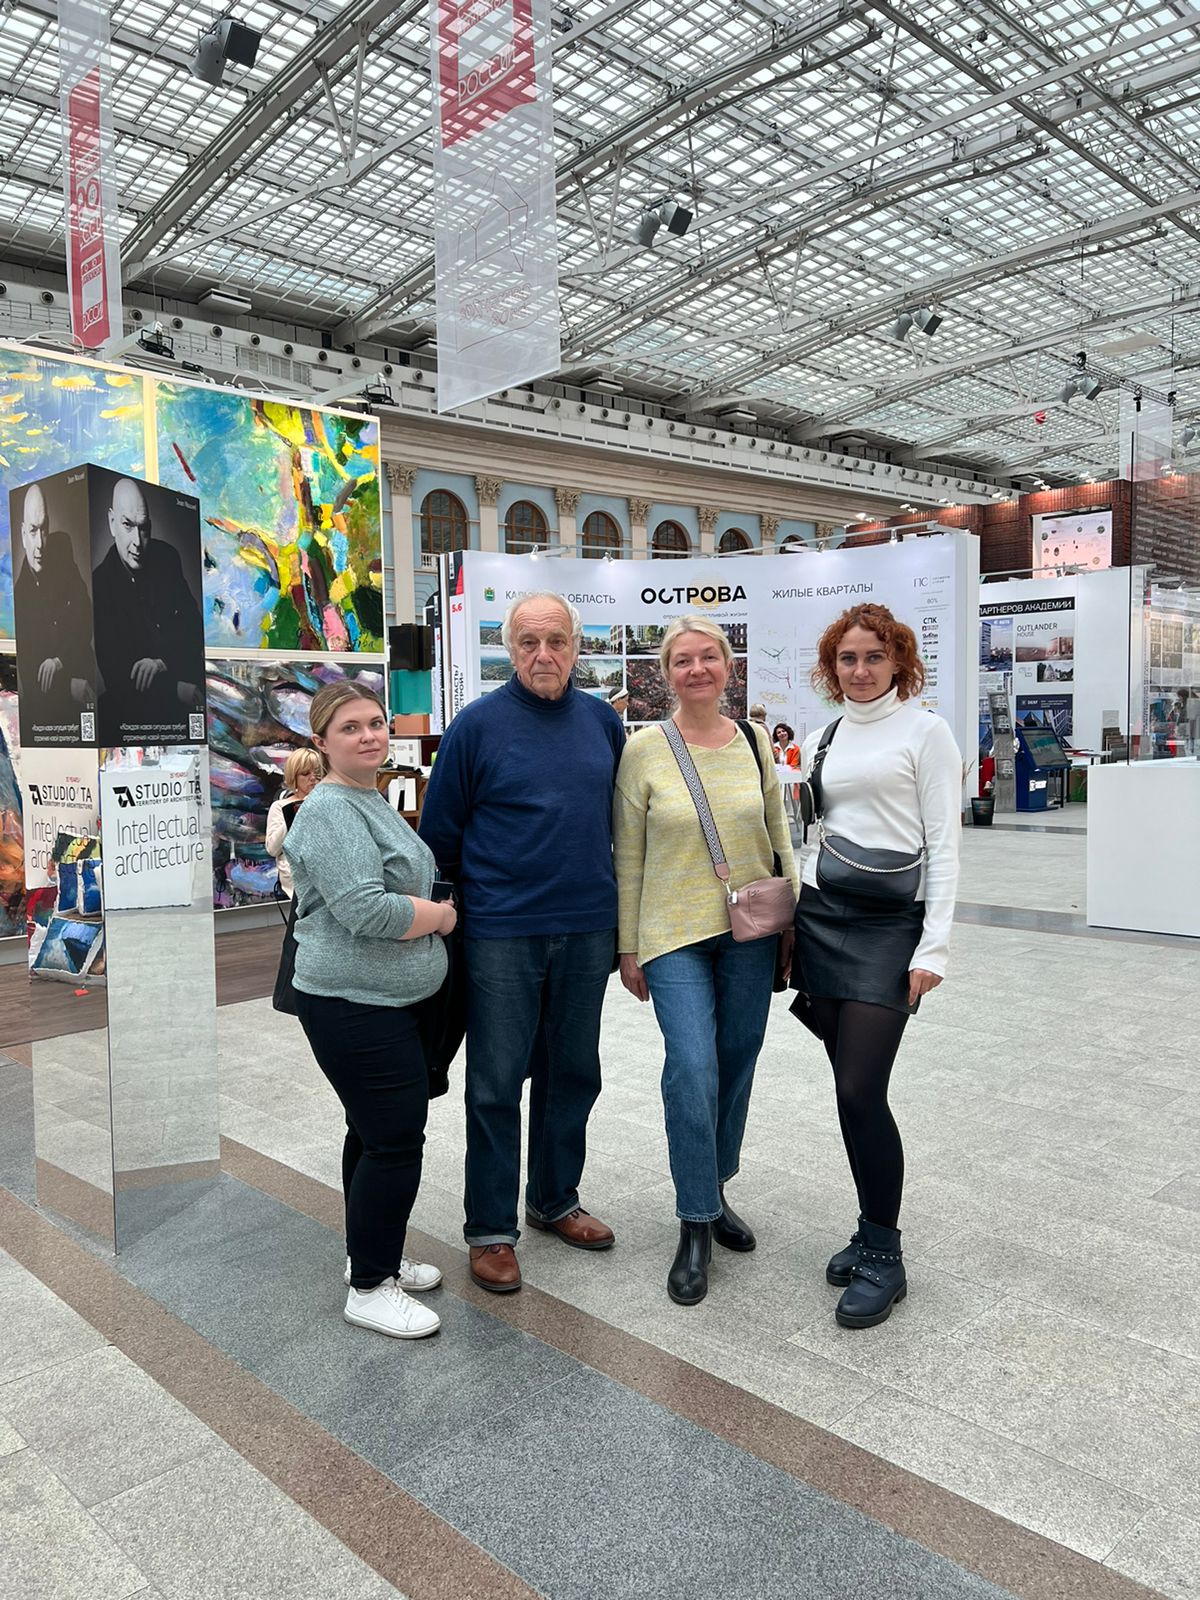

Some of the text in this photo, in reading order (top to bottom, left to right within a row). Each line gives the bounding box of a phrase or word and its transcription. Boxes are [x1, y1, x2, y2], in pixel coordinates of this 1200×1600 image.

[640, 585, 748, 605] ОСТРОВА
[772, 583, 873, 599] ЖИЛЫЕ КВАРТАЛЫ
[567, 593, 616, 604] ОБЛАСТЬ
[1024, 600, 1072, 611] АКАДЕМИИ
[452, 603, 463, 613] 5.6
[1017, 623, 1058, 632] OUTLANDER
[188, 780, 202, 794] TA
[81, 787, 93, 802] TA
[136, 798, 162, 807] TERRITORY
[117, 808, 201, 847] Intellectual
[114, 841, 204, 877] architecture
